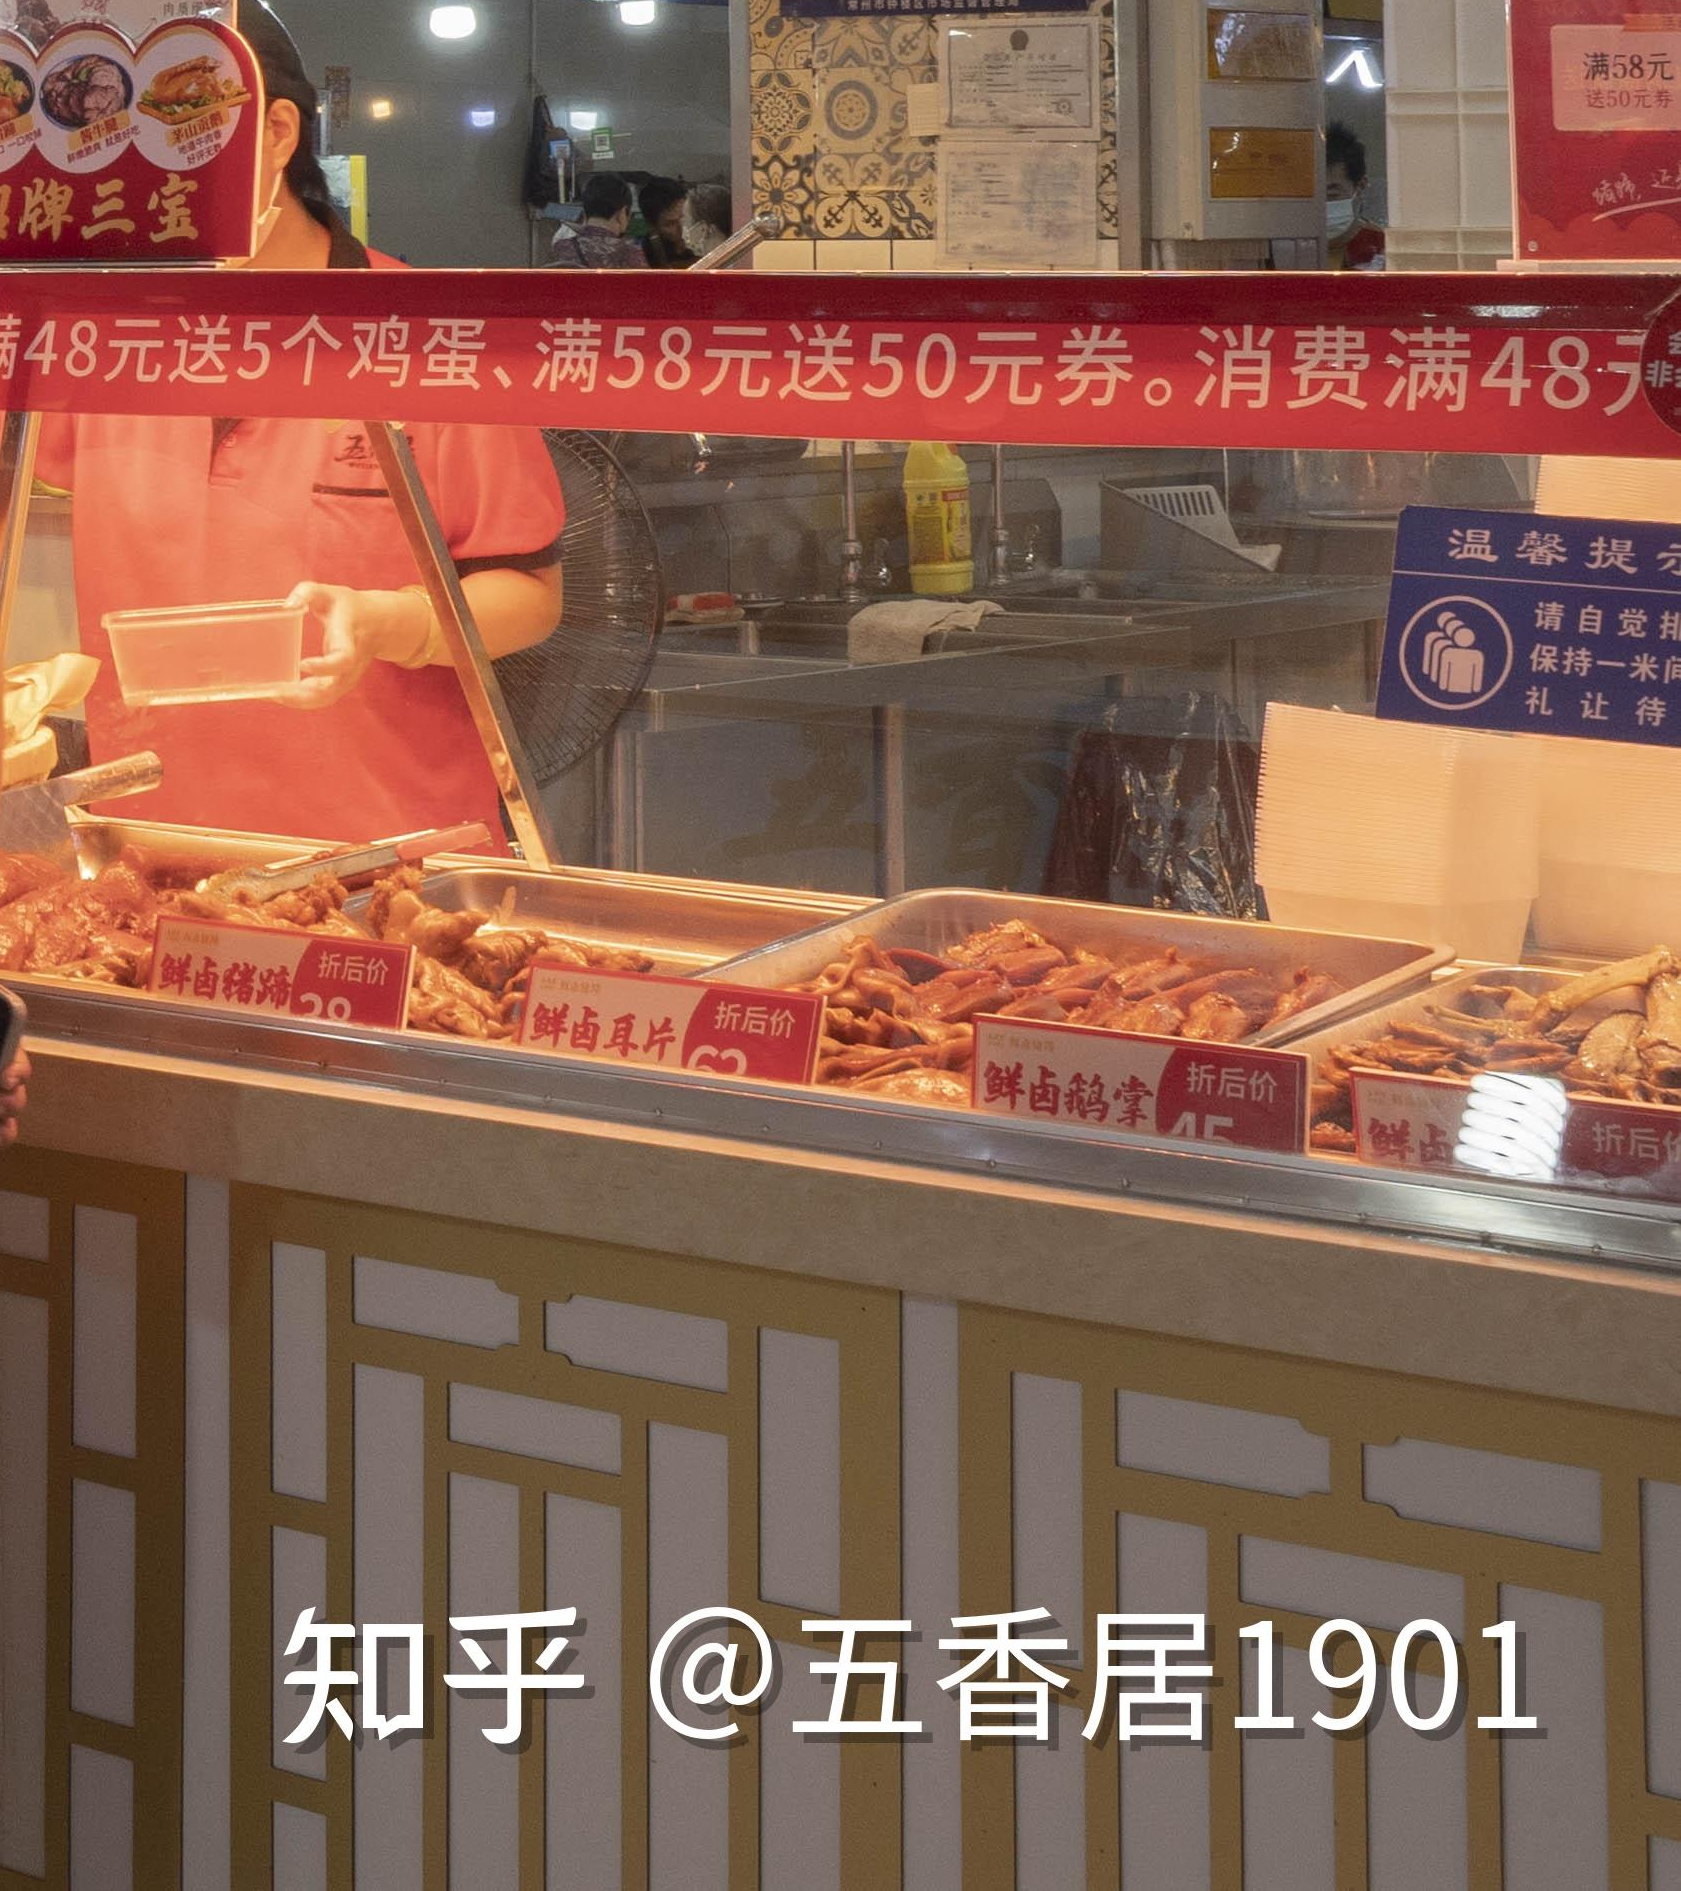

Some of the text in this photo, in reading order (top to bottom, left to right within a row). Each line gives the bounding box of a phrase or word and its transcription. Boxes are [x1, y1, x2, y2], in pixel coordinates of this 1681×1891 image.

[1582, 50, 1674, 82] 满58元
[1585, 87, 1674, 110] 送50元券
[1534, 600, 1681, 642] 请自觉排
[1525, 686, 1667, 728] 礼让待
[157, 951, 293, 1010] 鲜卤猪蹄
[318, 949, 390, 987] 折后价
[529, 1001, 677, 1063] 鲜卤耳片
[714, 1000, 797, 1040] 折后价
[982, 1060, 1278, 1129] 鲜卤鹅掌 折后价
